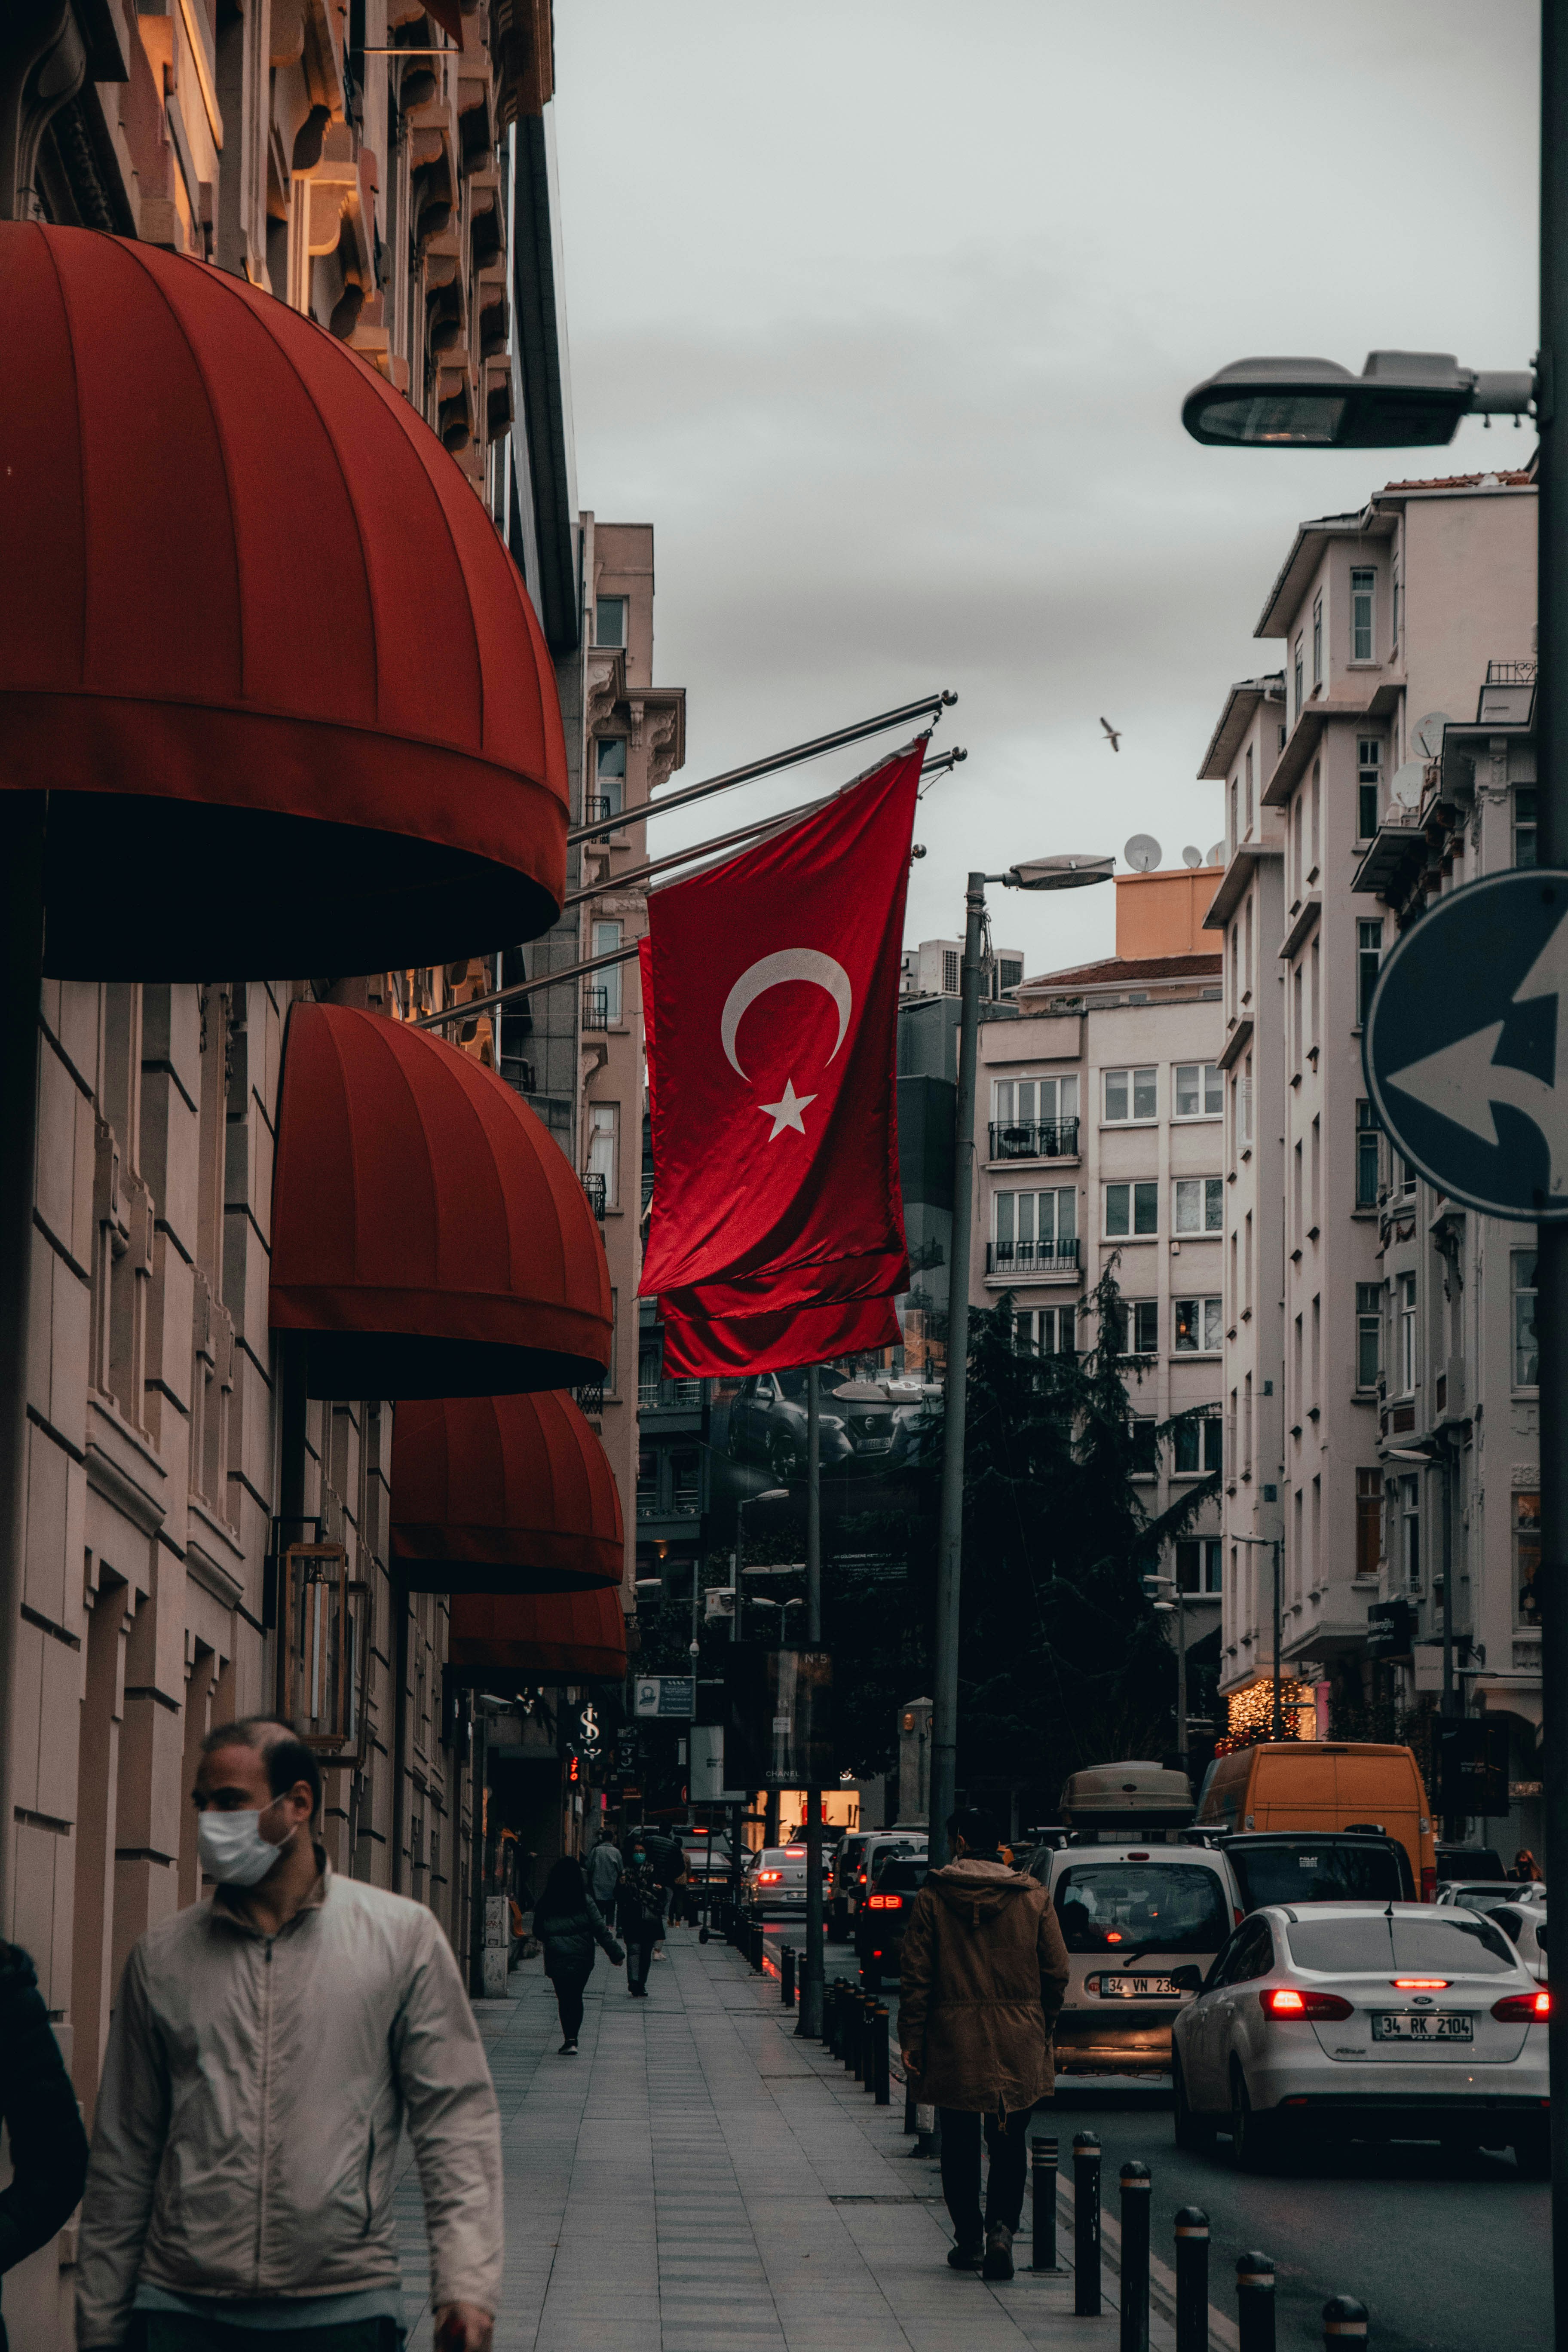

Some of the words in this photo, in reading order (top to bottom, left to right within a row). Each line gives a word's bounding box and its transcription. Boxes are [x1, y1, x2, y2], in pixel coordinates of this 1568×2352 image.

[820, 1654, 827, 1663] 5
[1109, 1979, 1124, 1992] 34
[1133, 1979, 1148, 1992] VN
[1384, 2018, 1401, 2033] 34
[1411, 2018, 1427, 2034] RK
[1437, 2018, 1469, 2034] 2104
